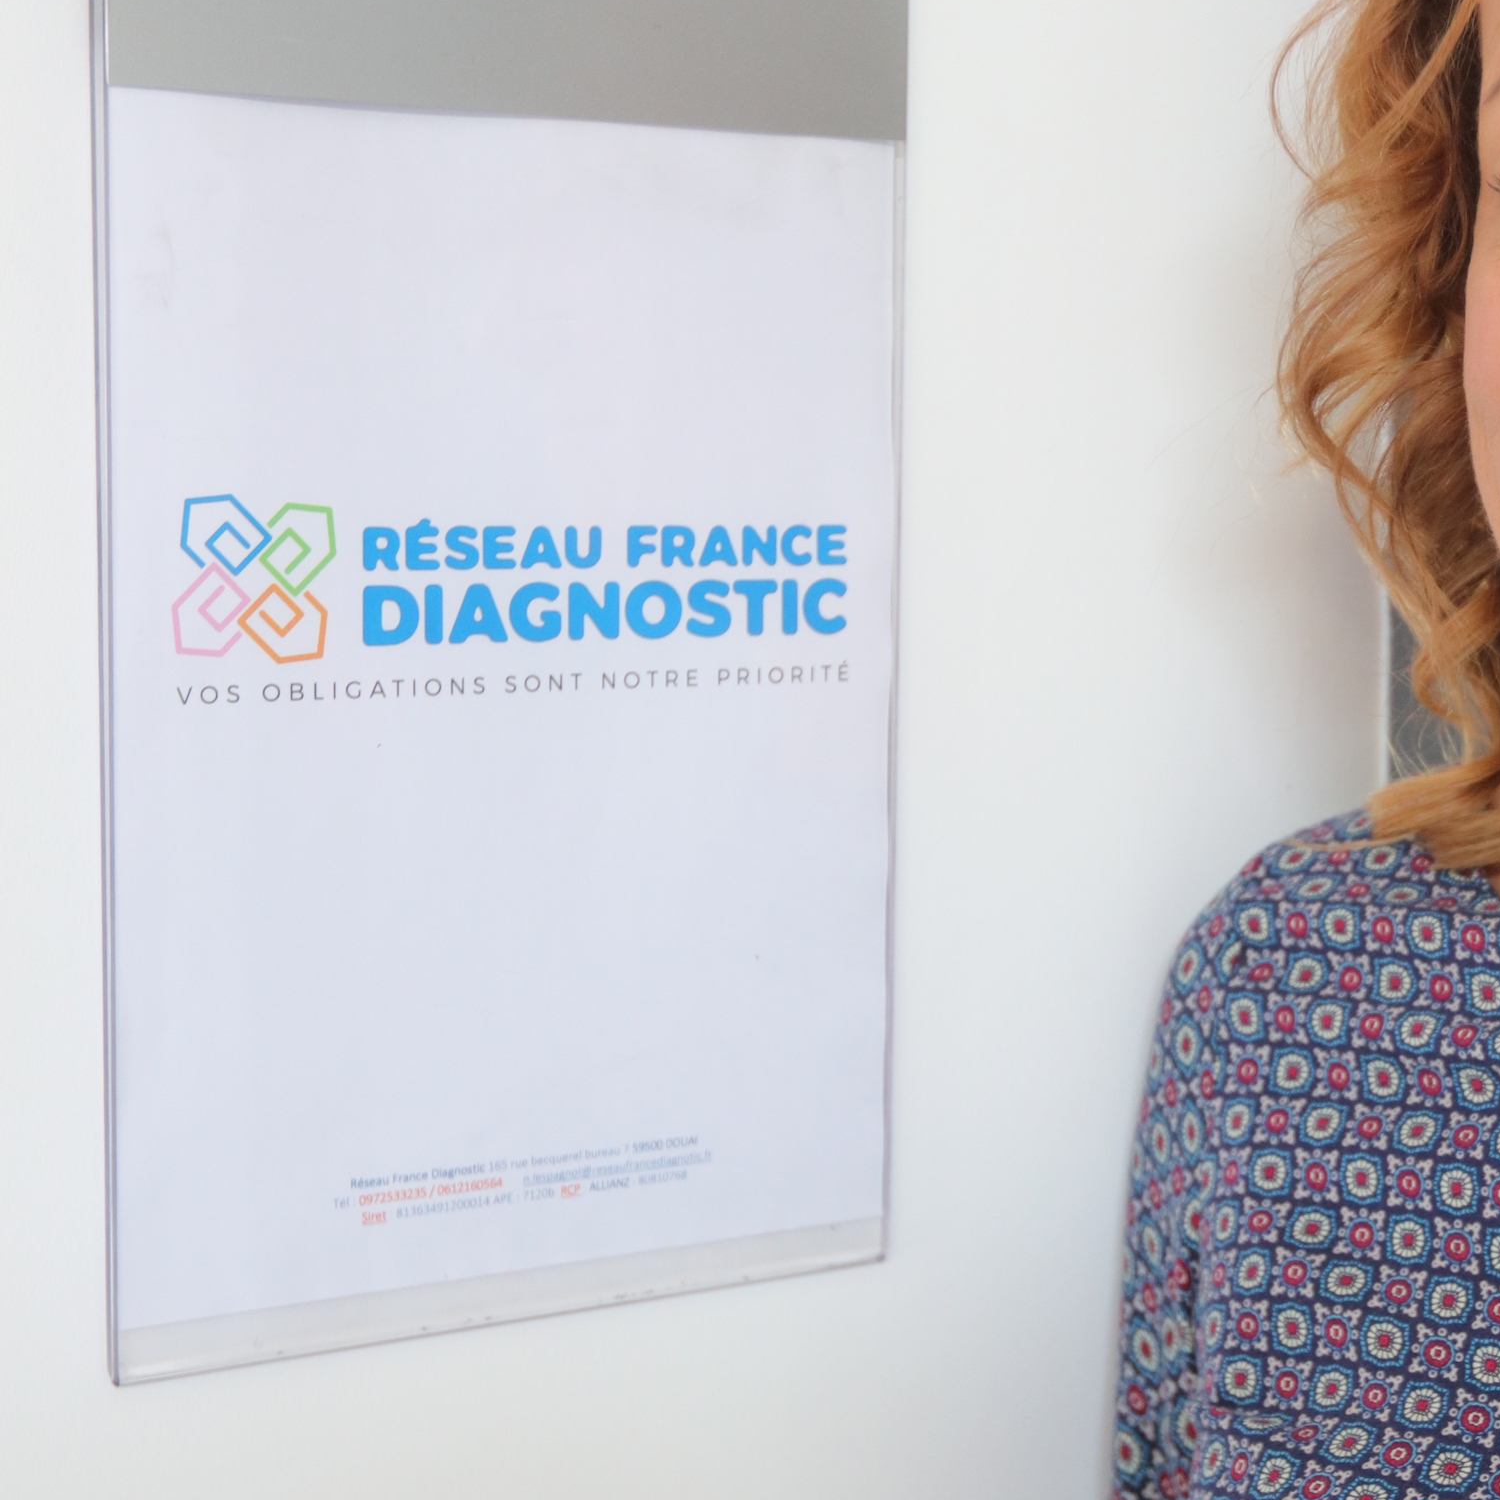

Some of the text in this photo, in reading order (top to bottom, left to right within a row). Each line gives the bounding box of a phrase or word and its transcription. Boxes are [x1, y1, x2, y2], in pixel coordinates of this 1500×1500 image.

[362, 518, 848, 571] RÉSEAU FRANCE
[361, 577, 848, 647] DIAGNOSTIC
[176, 660, 850, 706] VOS OBLIGATIONS SONT NOTRE PRIORITÉ
[350, 1176, 389, 1190] Réseau
[392, 1171, 428, 1184] France
[431, 1162, 485, 1180] Diagnostic
[489, 1158, 507, 1172] 165
[510, 1158, 528, 1169] rue
[531, 1149, 582, 1167] becquerel
[584, 1147, 620, 1160] bureau
[665, 1134, 698, 1149] DOUAI
[359, 1186, 427, 1206] 0972533235
[361, 1209, 387, 1226] Siret
[493, 1191, 513, 1205] APE
[560, 1183, 581, 1199] RCP
[589, 1176, 630, 1192] ALLIANZ
